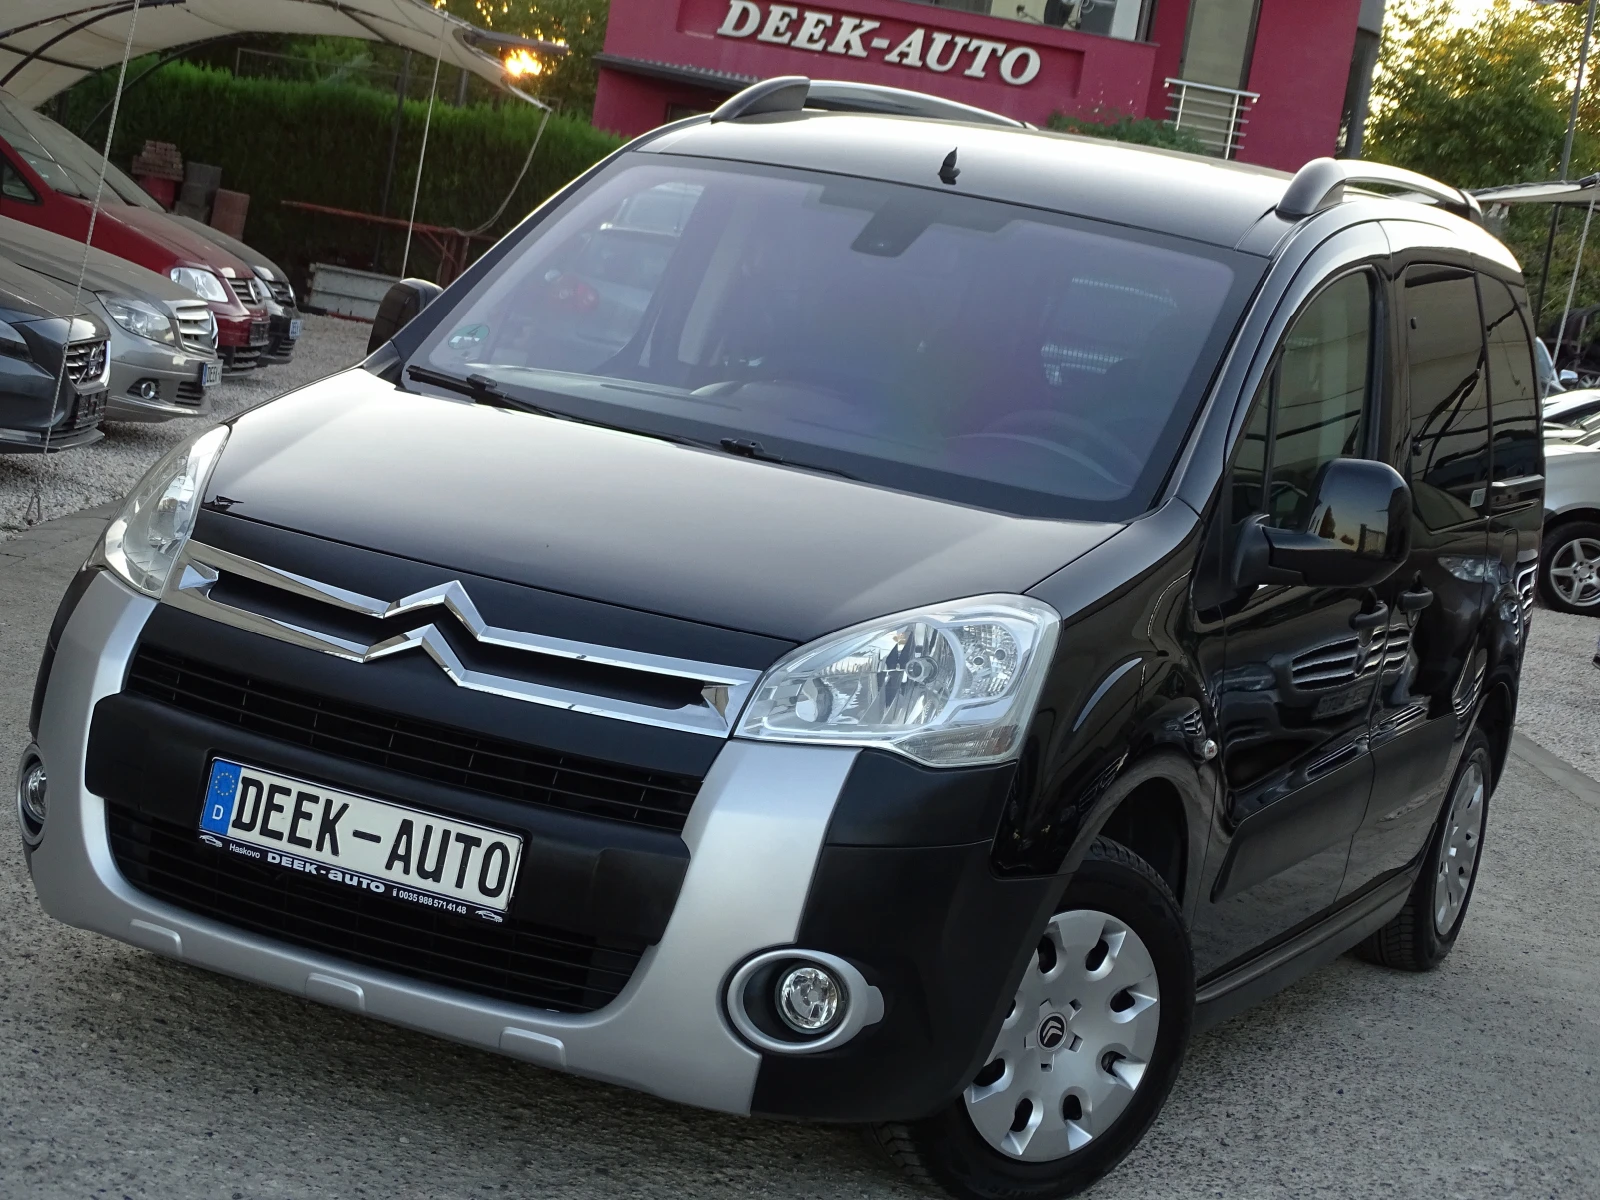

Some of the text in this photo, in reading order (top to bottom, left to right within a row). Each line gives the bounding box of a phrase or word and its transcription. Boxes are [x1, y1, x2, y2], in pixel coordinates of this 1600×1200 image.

[717, 0, 1041, 86] DEEK-AUTO
[211, 804, 224, 821] D
[231, 776, 511, 899] DEEK-AUTO
[229, 843, 261, 859] Haskovo
